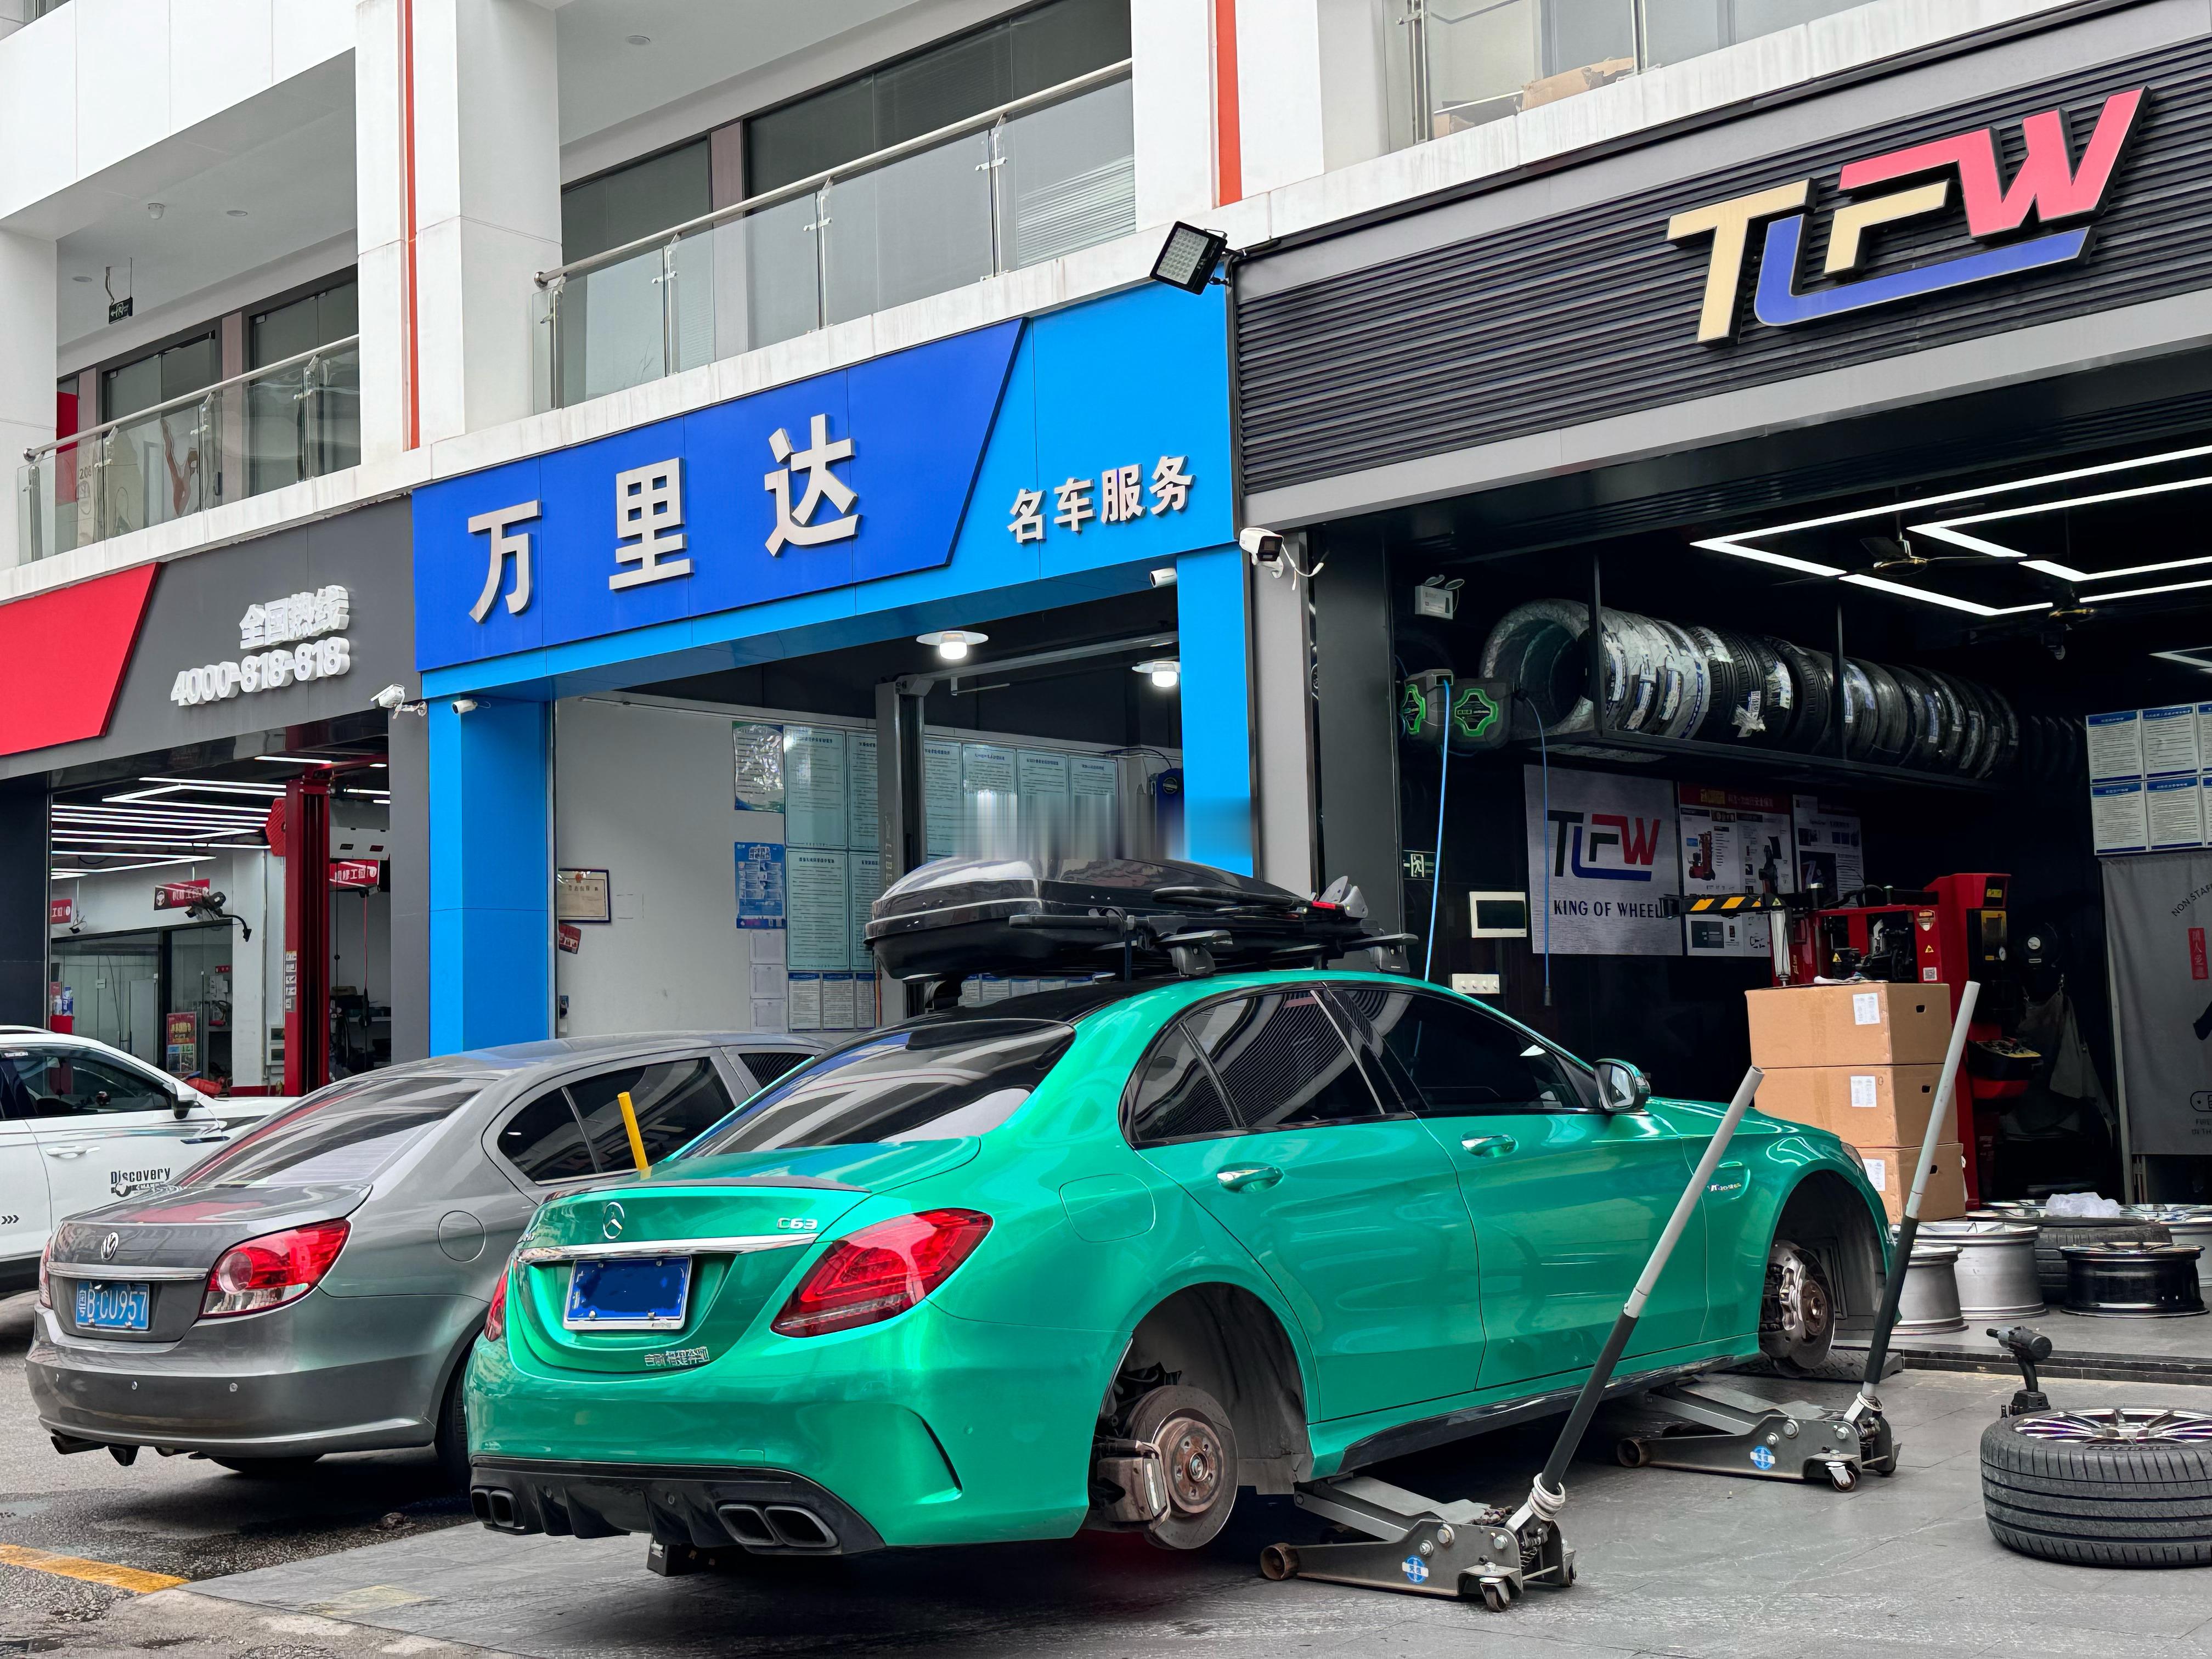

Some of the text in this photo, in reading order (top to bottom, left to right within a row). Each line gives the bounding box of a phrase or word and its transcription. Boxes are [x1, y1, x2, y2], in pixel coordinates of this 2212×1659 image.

[467, 413, 862, 624] 万里达
[1007, 455, 1195, 544] 名车服务
[239, 584, 349, 650] 全国热线
[170, 636, 351, 707] 4000-818-818
[1554, 899, 1588, 917] KING
[1593, 901, 1612, 917] OF
[2171, 898, 2191, 917] NON
[111, 1167, 171, 1184] Discovery
[777, 1217, 818, 1230] C63
